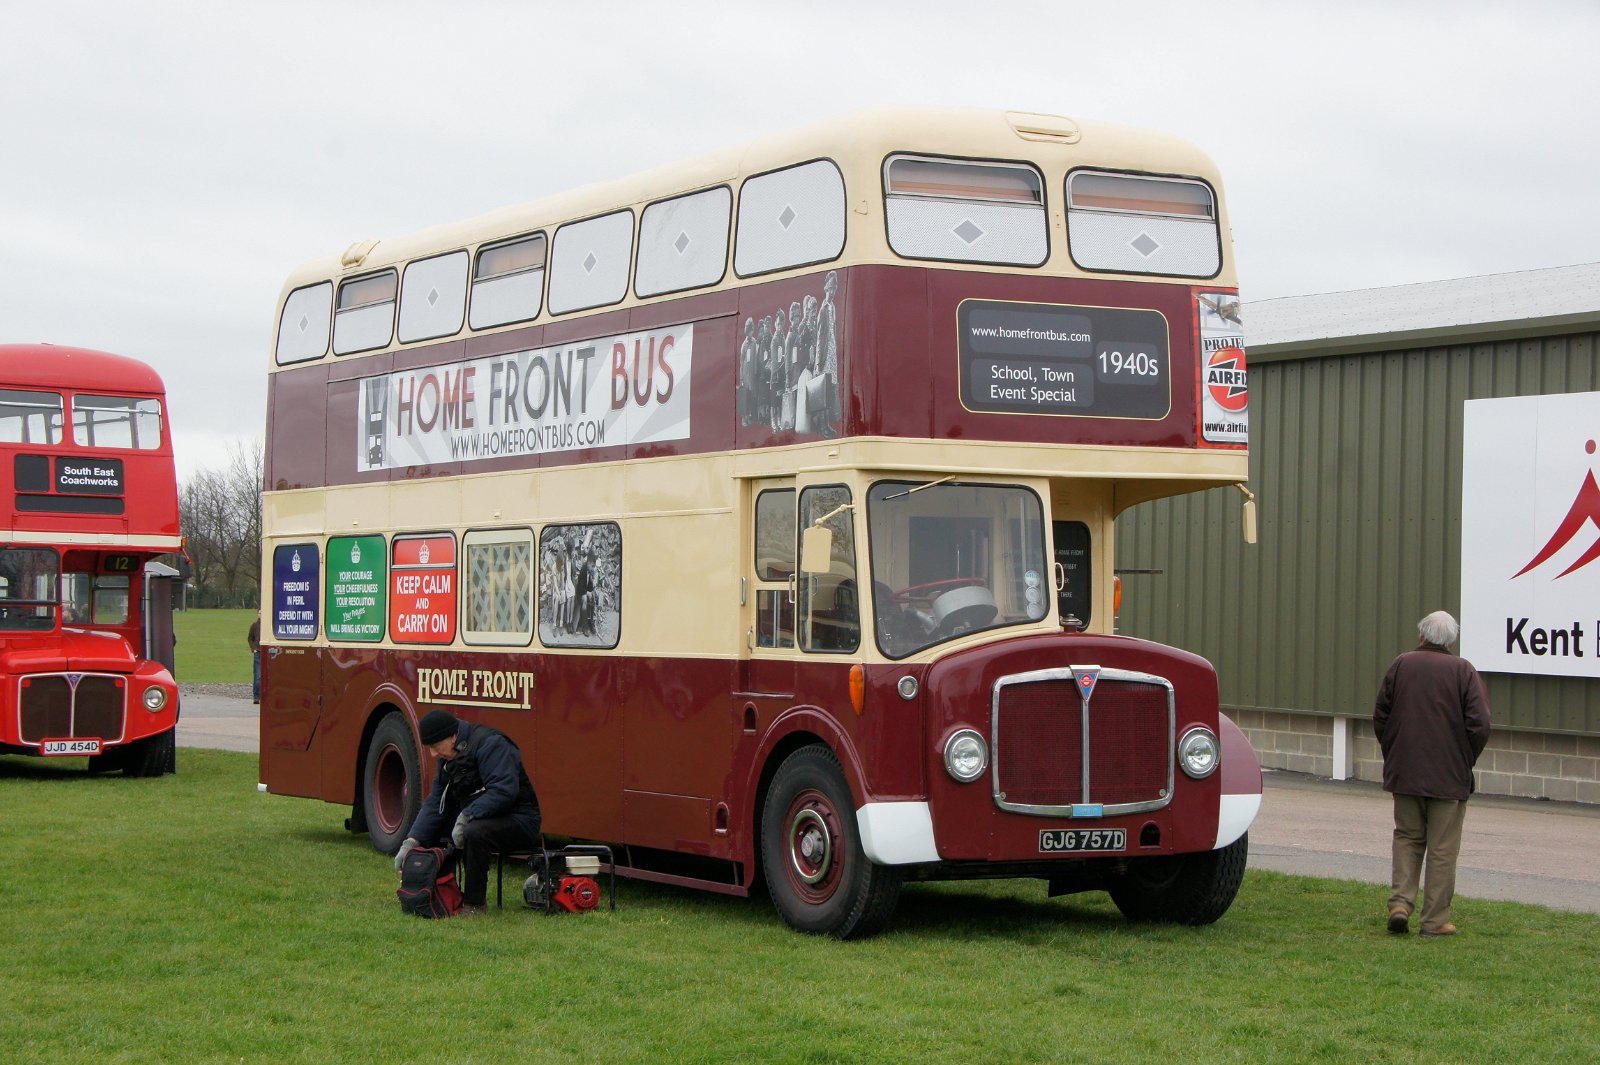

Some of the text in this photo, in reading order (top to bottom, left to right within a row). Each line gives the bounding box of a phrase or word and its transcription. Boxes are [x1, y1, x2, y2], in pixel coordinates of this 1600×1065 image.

[971, 326, 1091, 343] www.homefrontbus.com
[1099, 351, 1159, 377] 1940s
[991, 365, 1074, 384] School, Town
[397, 334, 675, 437] HOME FRONT BUS
[990, 385, 1076, 404] Event Special
[450, 419, 605, 459] WWW.HOMEFRONTBUS.COM
[64, 466, 115, 477] South East
[60, 476, 119, 487] Coachworks
[115, 557, 129, 570] 12
[339, 571, 372, 581] YOUR COURAGE
[283, 582, 310, 592] FREEDOM IS
[334, 584, 378, 594] YOUR CHEERFULNESS
[396, 575, 450, 594] KEEP CALM
[287, 596, 305, 606] IN PERIL
[336, 597, 375, 606] YOUR RESOLUTION
[415, 598, 430, 609] AND
[279, 611, 314, 620] DEFEND IT WITH
[330, 624, 380, 634] WILL BRING US VICTORY
[397, 614, 448, 633] CARRY ON
[278, 625, 314, 635] ALL YOUR MIGHT
[1506, 618, 1583, 657] Kent
[416, 668, 534, 709] HOME FRONT
[46, 742, 98, 752] JJD 454D
[1042, 831, 1124, 849] GJG 757D
